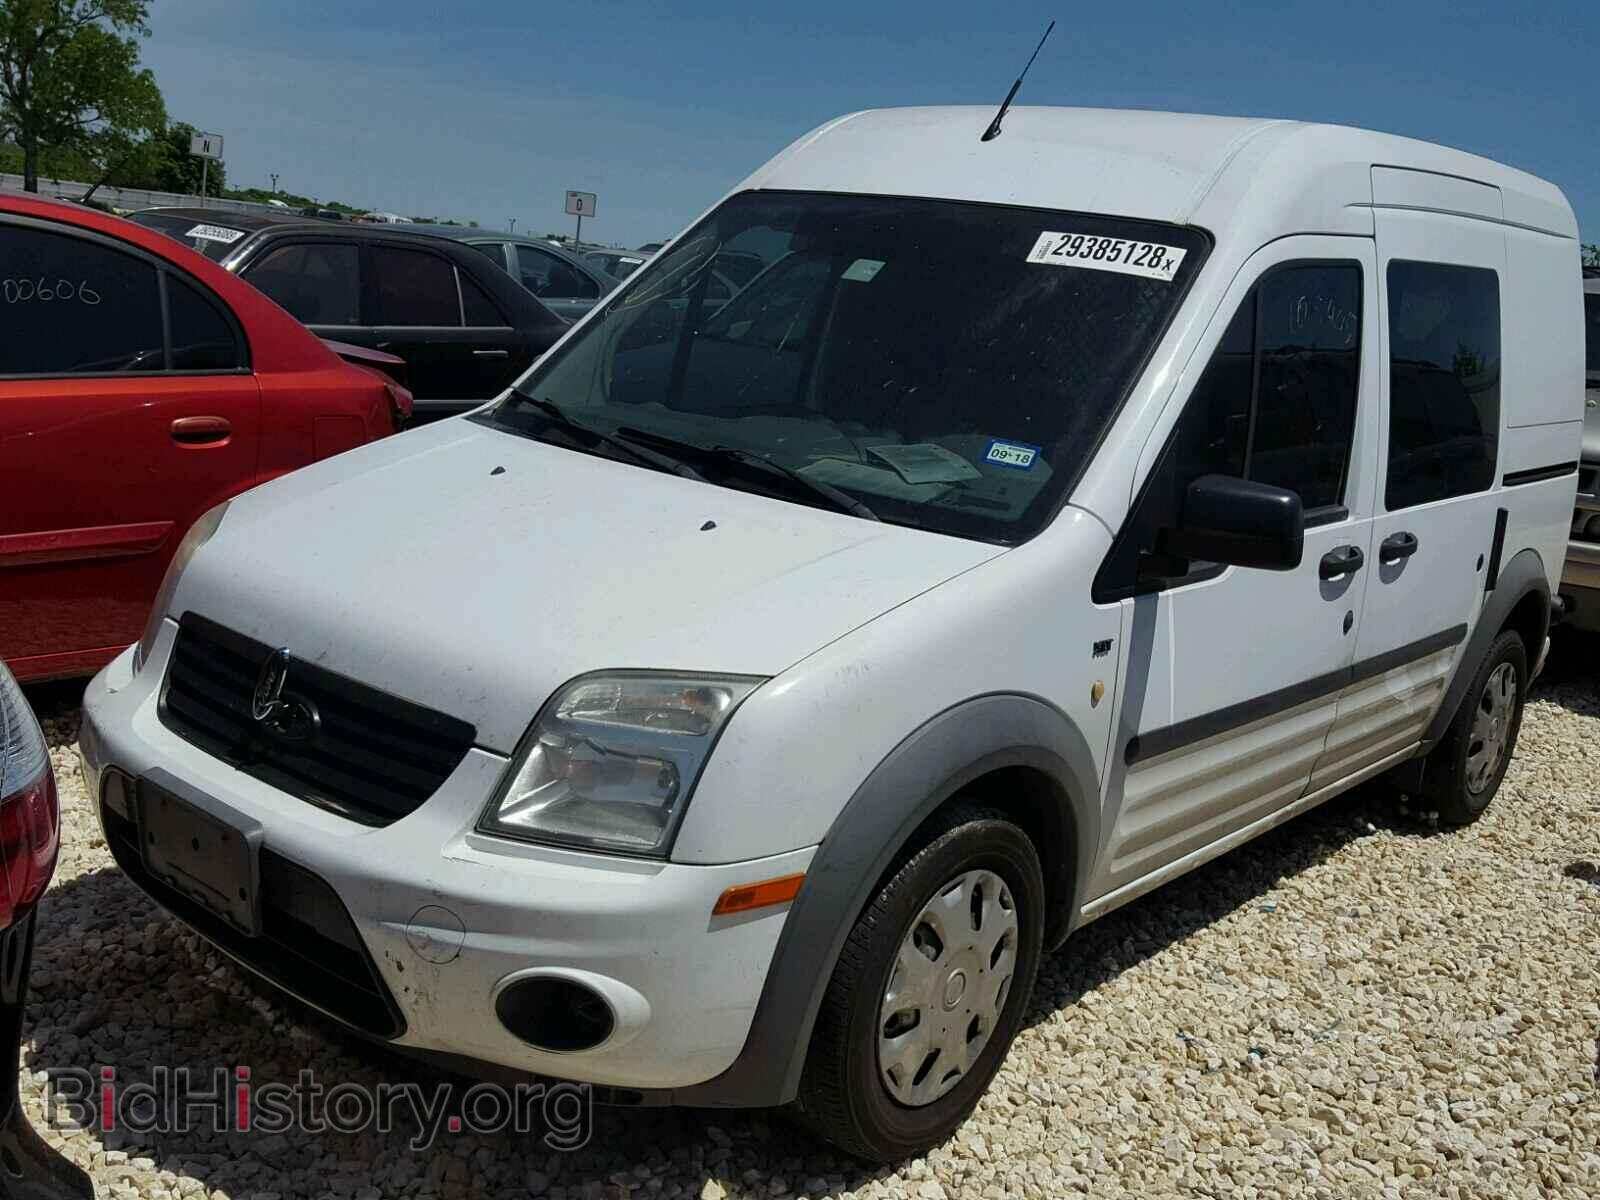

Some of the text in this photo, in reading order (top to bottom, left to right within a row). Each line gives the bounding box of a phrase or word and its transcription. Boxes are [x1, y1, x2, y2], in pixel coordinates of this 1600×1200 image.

[203, 139, 210, 153] N
[991, 448, 1008, 459] 09
[1015, 453, 1030, 464] 18
